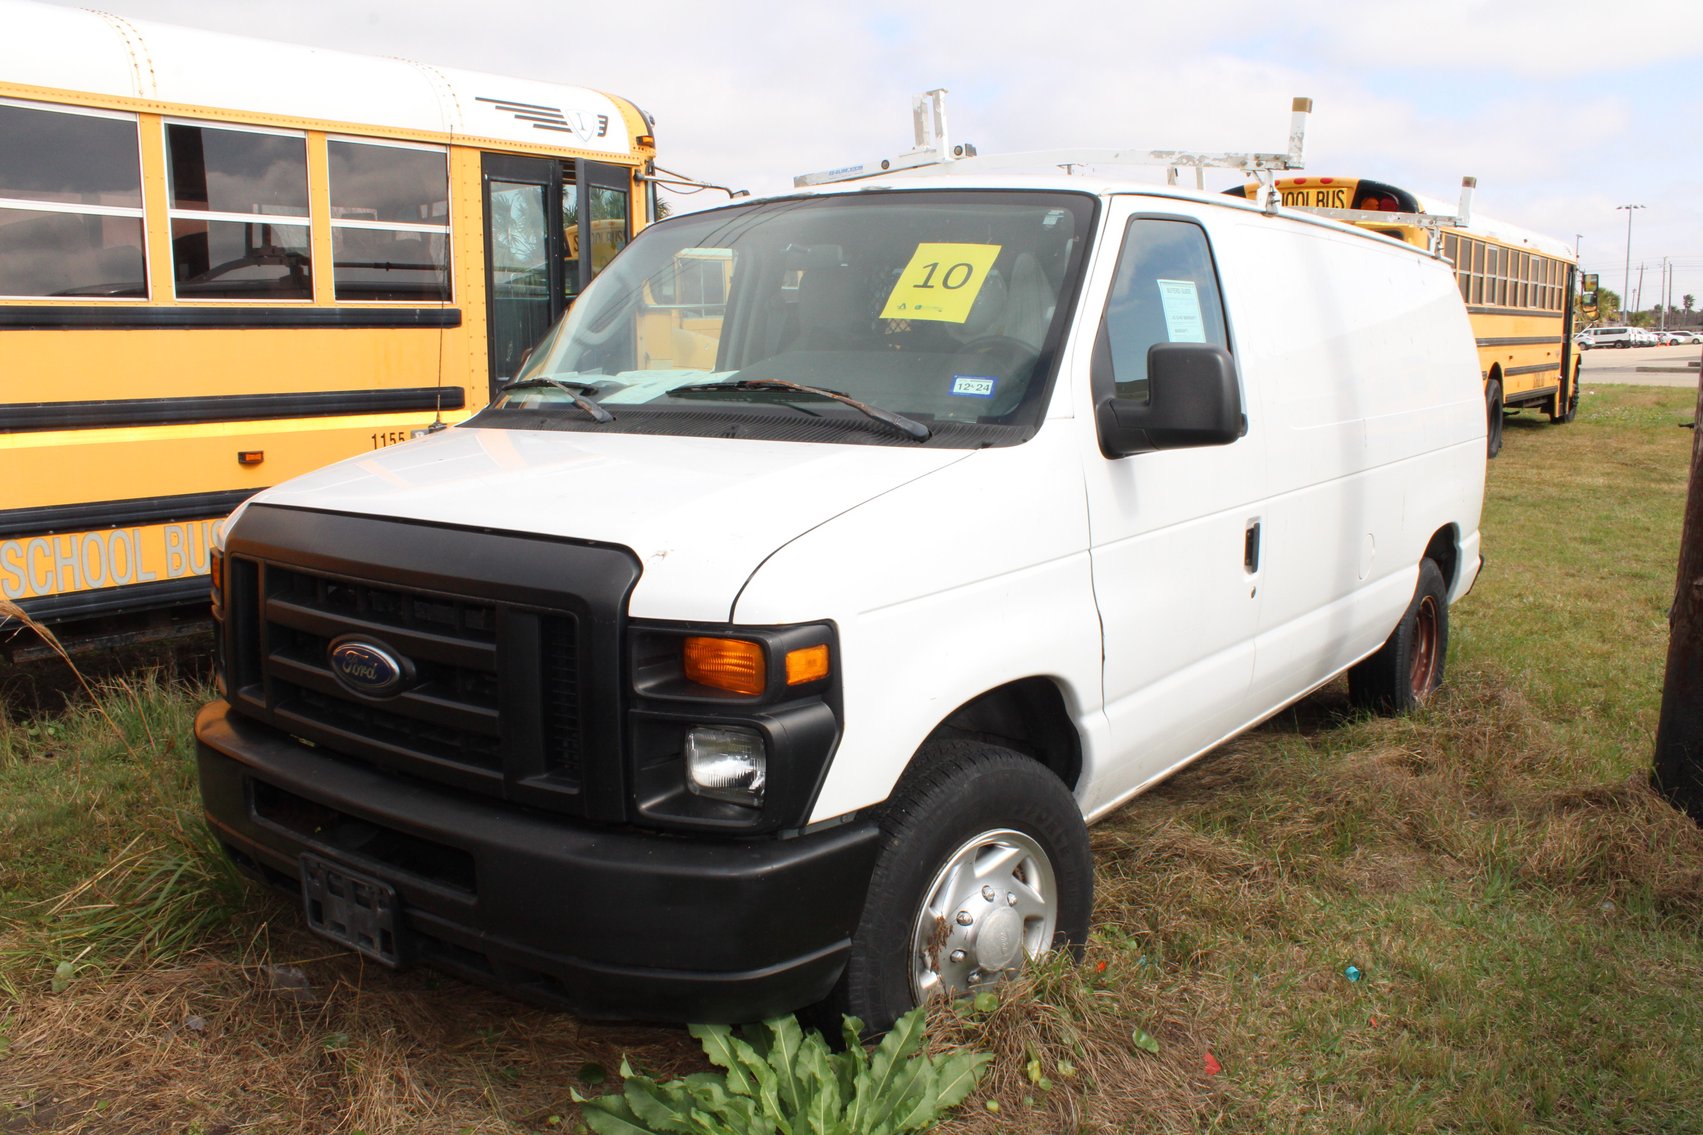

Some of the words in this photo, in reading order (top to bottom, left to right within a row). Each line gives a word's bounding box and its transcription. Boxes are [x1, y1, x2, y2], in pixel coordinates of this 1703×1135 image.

[1316, 189, 1345, 209] BUS
[912, 261, 974, 290] 10
[958, 382, 971, 391] 12
[975, 383, 990, 392] 24
[371, 431, 406, 450] 1155
[0, 528, 157, 599] SCHOOL
[342, 650, 378, 680] Ford
